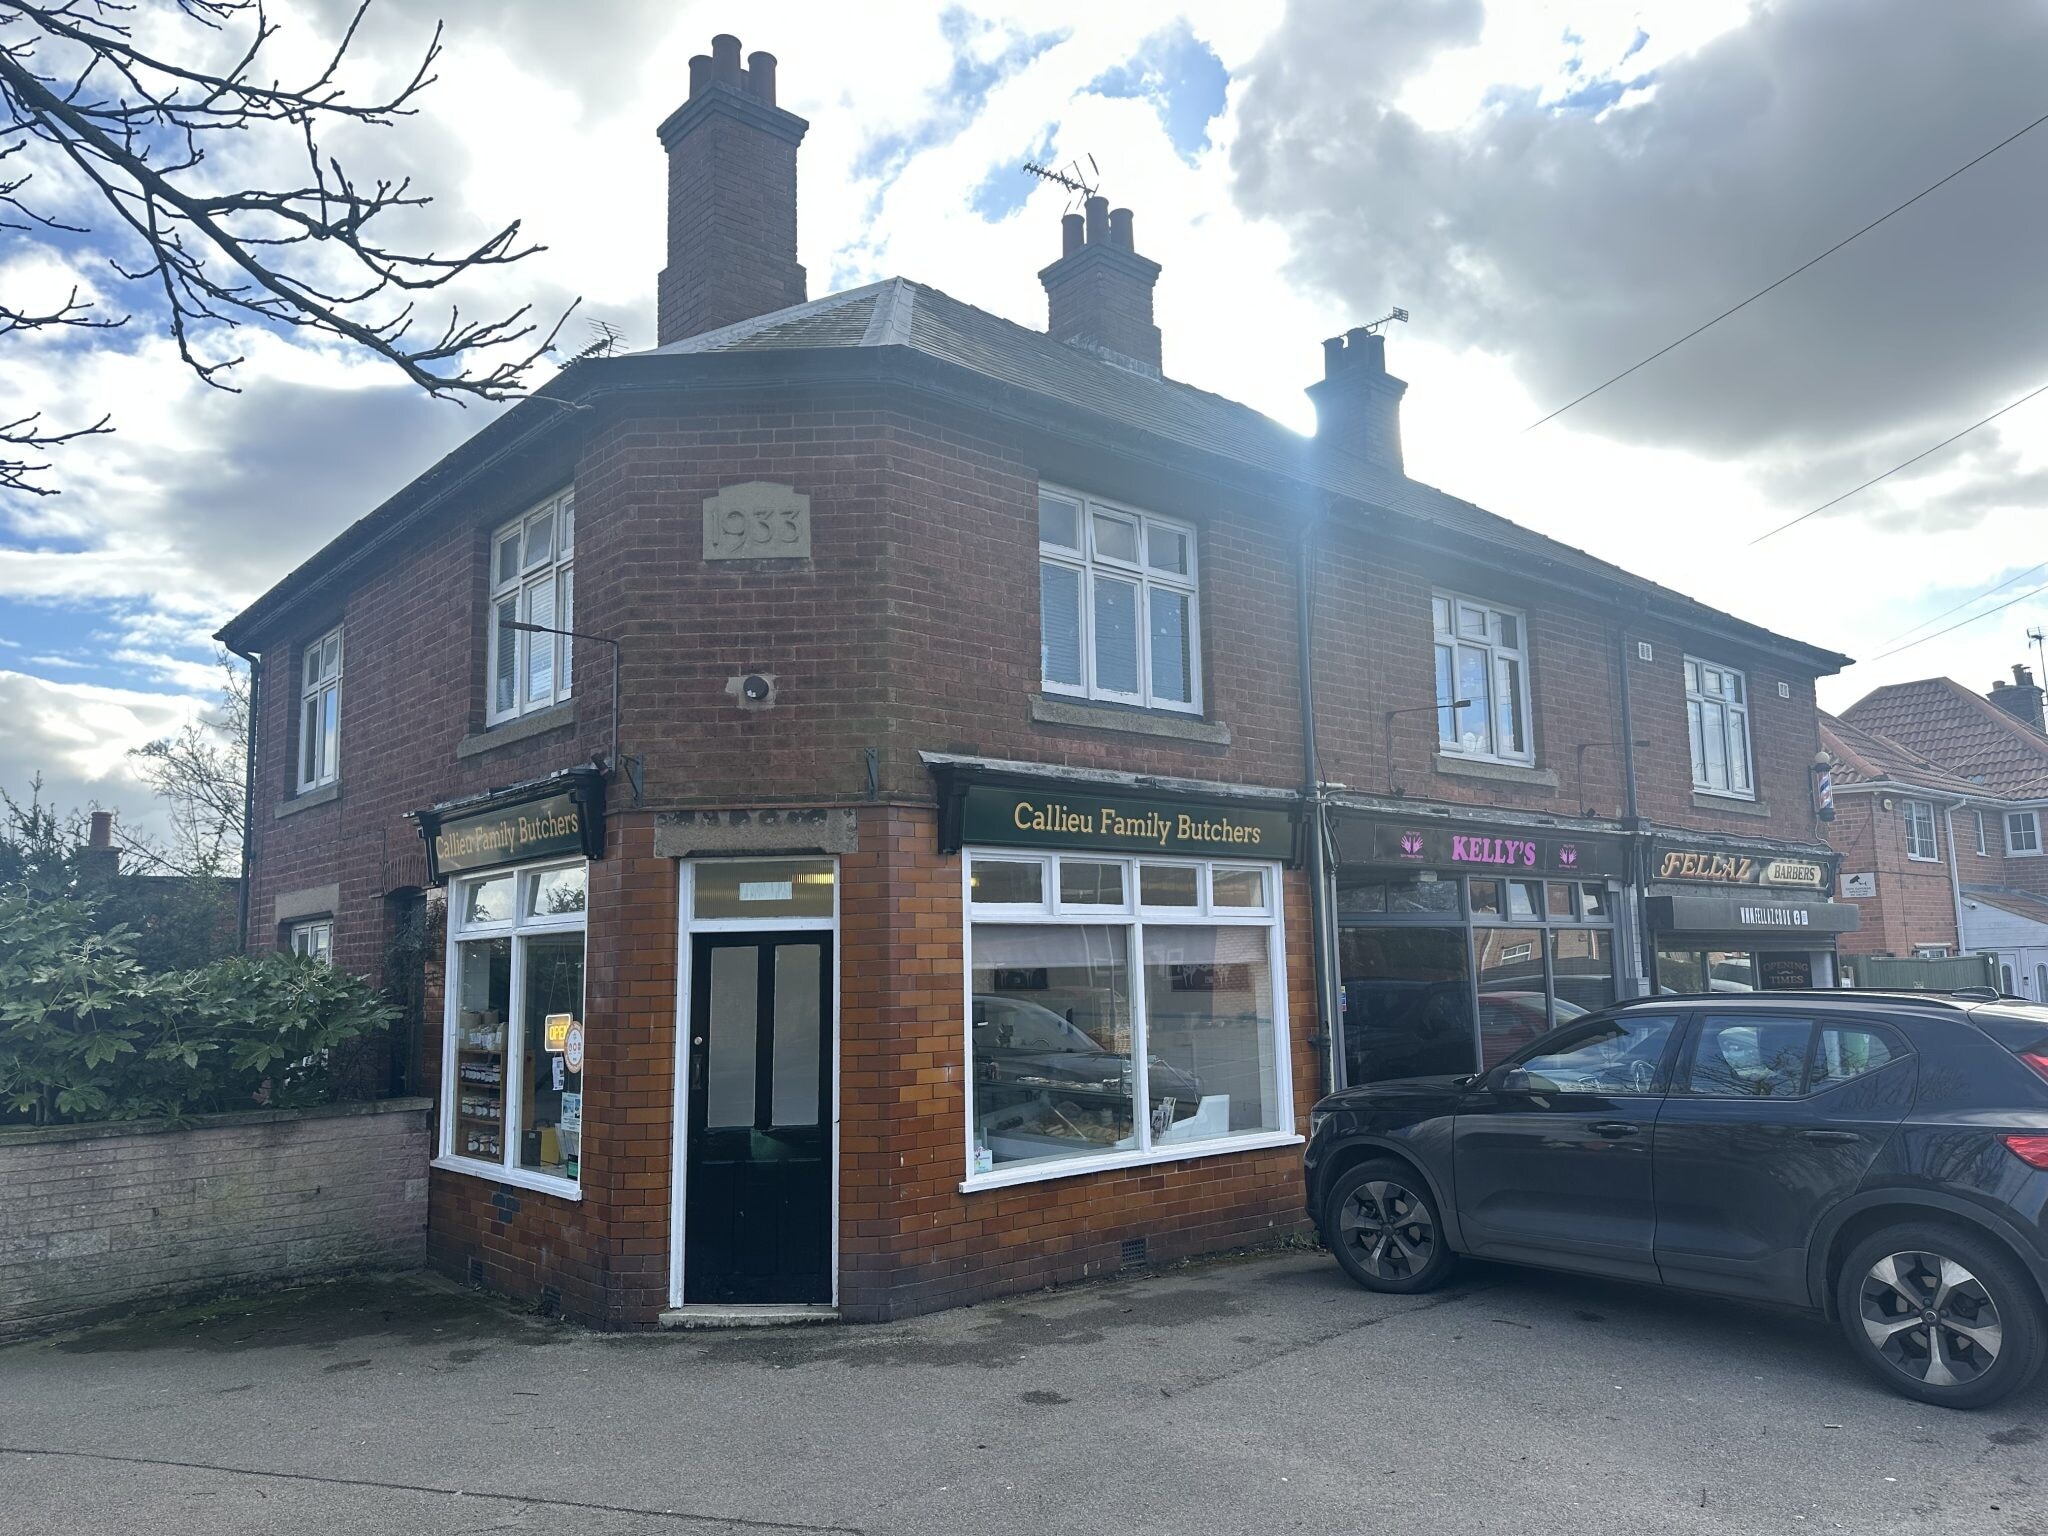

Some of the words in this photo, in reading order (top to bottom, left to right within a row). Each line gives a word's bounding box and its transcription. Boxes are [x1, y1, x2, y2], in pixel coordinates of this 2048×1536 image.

[711, 509, 801, 553] 1933
[435, 831, 473, 859] Callieu
[474, 820, 515, 853] Family
[518, 810, 579, 843] Butchers
[1014, 801, 1093, 834] Callieu
[1100, 808, 1172, 846] Family
[1177, 814, 1262, 844] Butchers
[1451, 835, 1537, 866] KELLY'S
[1660, 852, 1751, 881] FELLAZ
[1773, 864, 1816, 881] BARBERS
[1762, 961, 1809, 972] OPENING
[1768, 975, 1805, 984] TIMES
